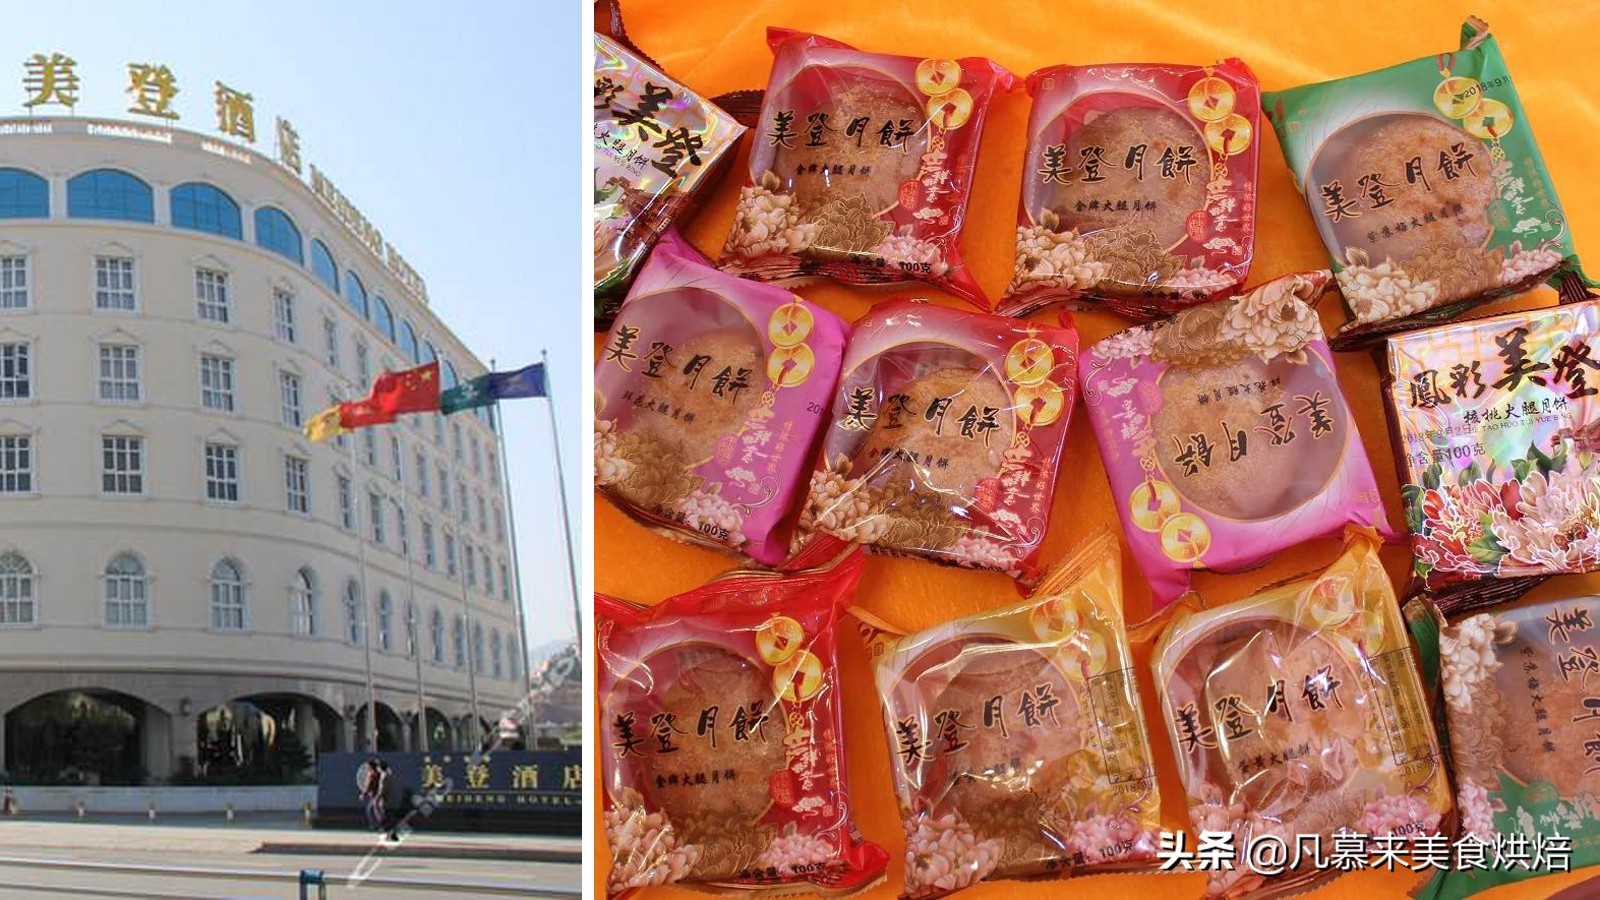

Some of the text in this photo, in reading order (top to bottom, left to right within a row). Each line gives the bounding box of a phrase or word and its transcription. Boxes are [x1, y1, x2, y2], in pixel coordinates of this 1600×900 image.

[23, 53, 302, 174] 美登酒店
[766, 110, 915, 154] 美登月餅
[1037, 144, 1198, 184] 美登月餅
[1320, 142, 1478, 223] 美登月餅
[1073, 200, 1158, 213] 金牌火腿月饼
[605, 324, 753, 405] 美登月餅
[837, 387, 1002, 448] 美登月餅
[1173, 391, 1334, 478] 美登月餅
[1463, 397, 1568, 424] 核桃火腿月饼
[697, 521, 729, 541] 100克
[612, 701, 770, 758] 美登月餅
[896, 683, 1060, 765] 美登月餅
[1100, 839, 1134, 858] 100克
